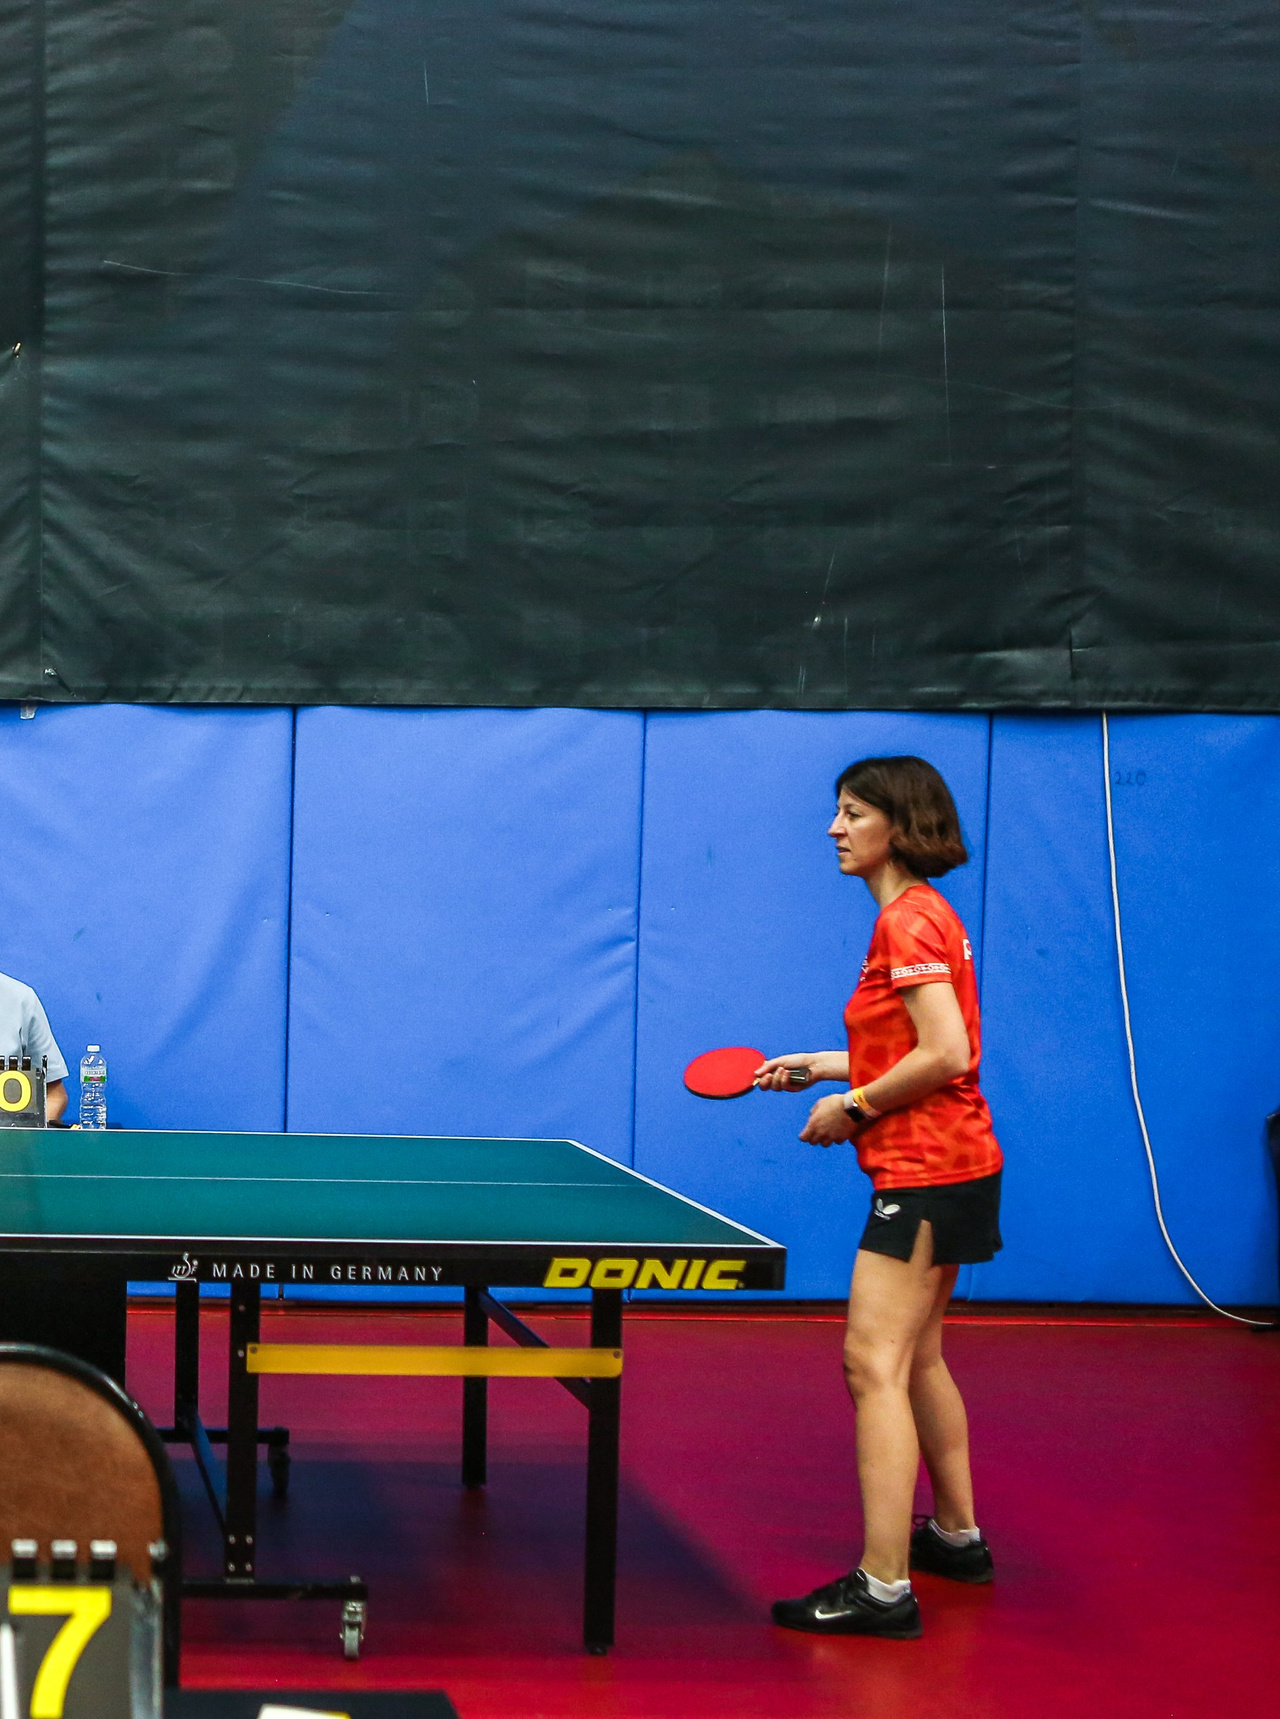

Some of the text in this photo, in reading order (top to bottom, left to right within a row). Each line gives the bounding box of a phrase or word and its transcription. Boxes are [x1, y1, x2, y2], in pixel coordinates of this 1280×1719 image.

[213, 1263, 443, 1281] MADE IN GERMANY
[542, 1257, 747, 1290] DONIC
[8, 1585, 112, 1719] 7
